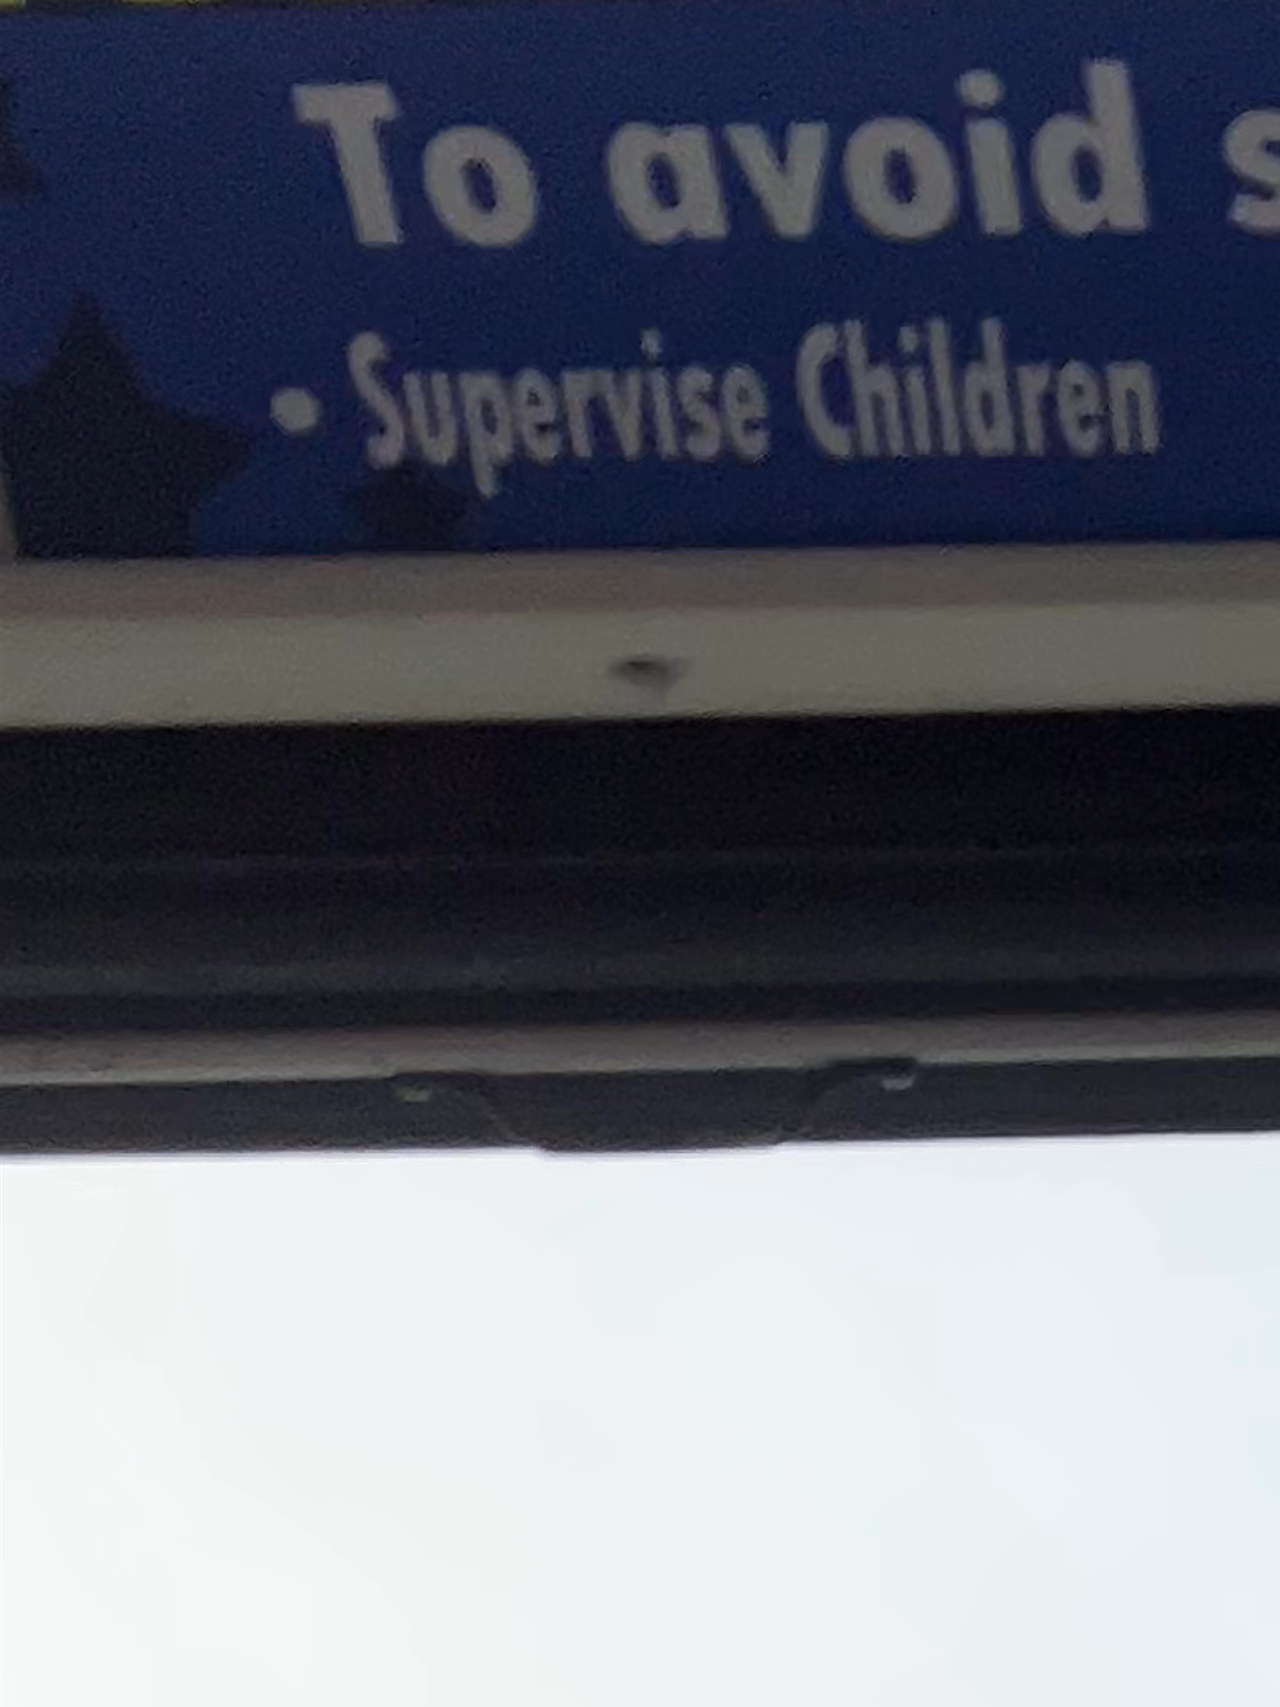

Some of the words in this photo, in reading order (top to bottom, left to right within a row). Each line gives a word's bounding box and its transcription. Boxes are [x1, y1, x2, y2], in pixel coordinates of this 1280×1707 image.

[292, 82, 538, 248] To
[605, 57, 1149, 245] avoid
[345, 329, 770, 499] Supervise
[794, 317, 1161, 460] Children
